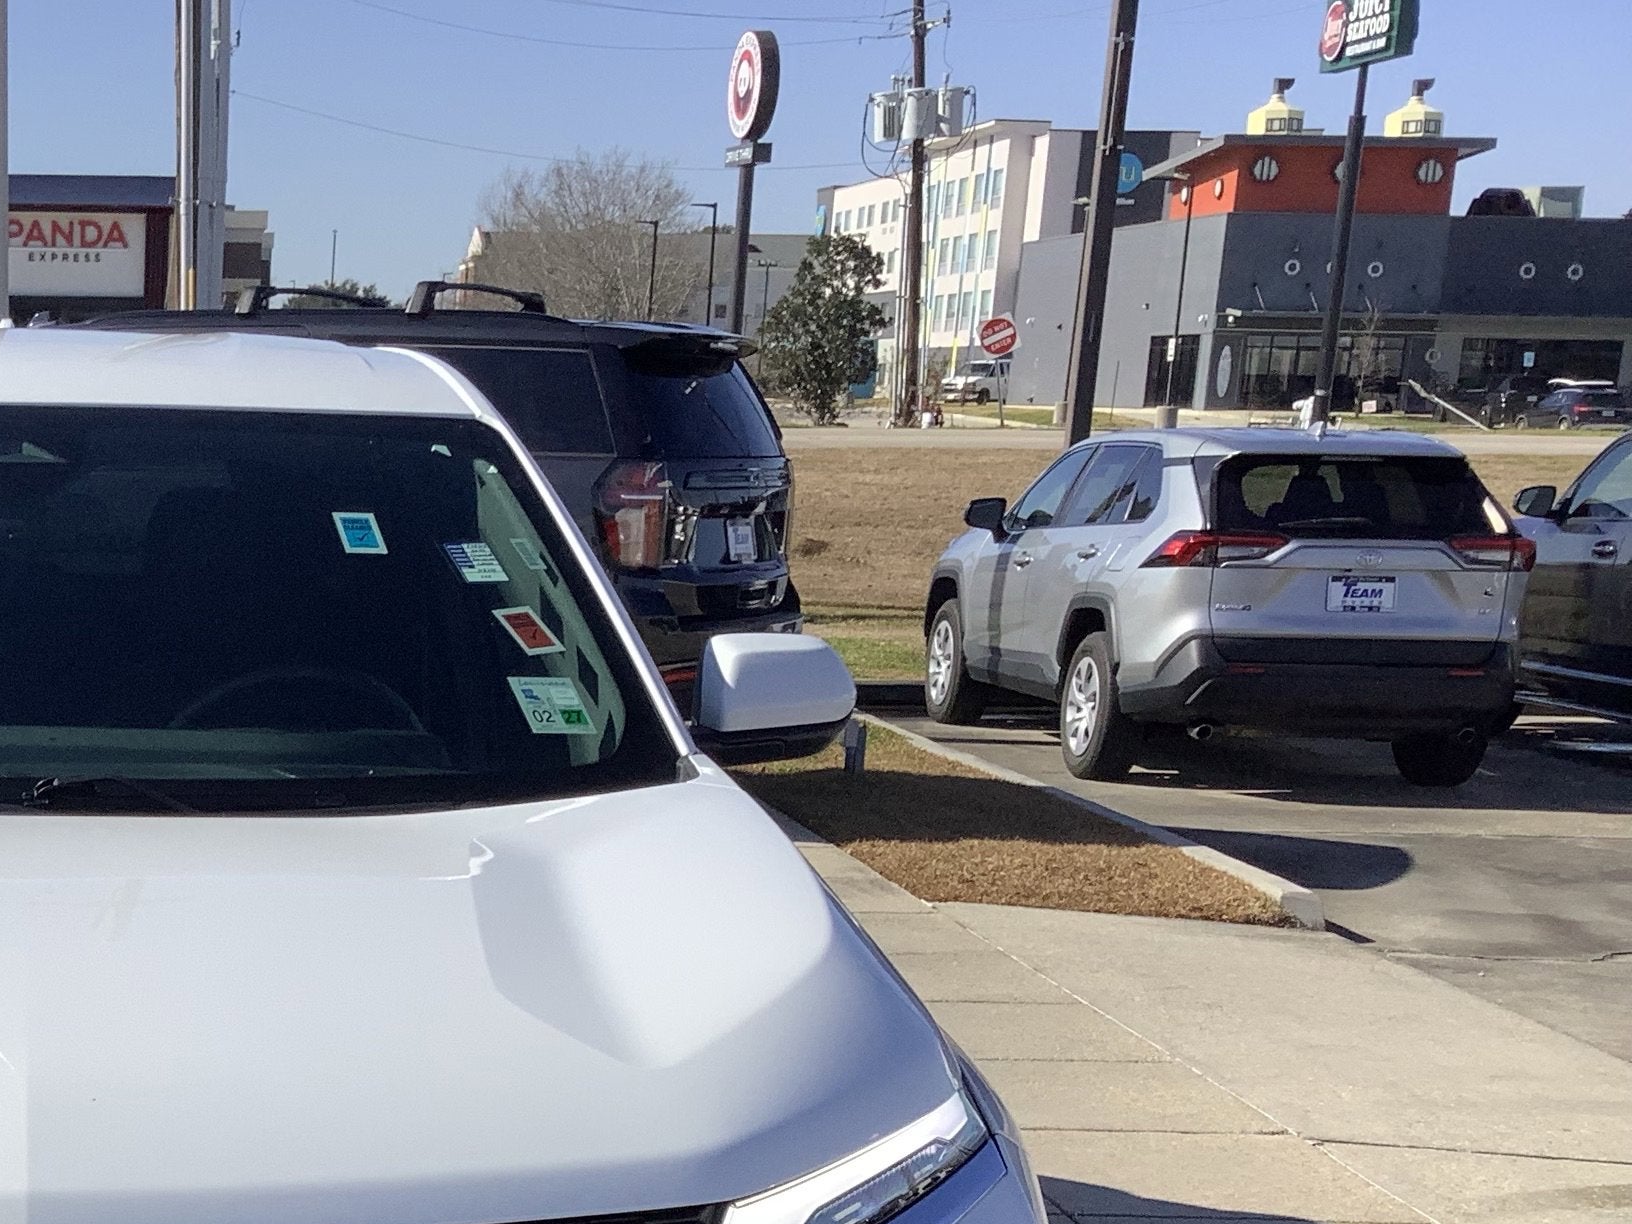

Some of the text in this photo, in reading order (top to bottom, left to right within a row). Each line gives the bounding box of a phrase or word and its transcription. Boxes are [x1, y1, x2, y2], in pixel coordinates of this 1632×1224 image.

[1346, 13, 1389, 42] SEAFOOD
[8, 218, 128, 248] PANDA
[28, 252, 101, 262] EXPRESS
[1343, 580, 1384, 599] TEAM
[532, 709, 582, 724] 02 27
